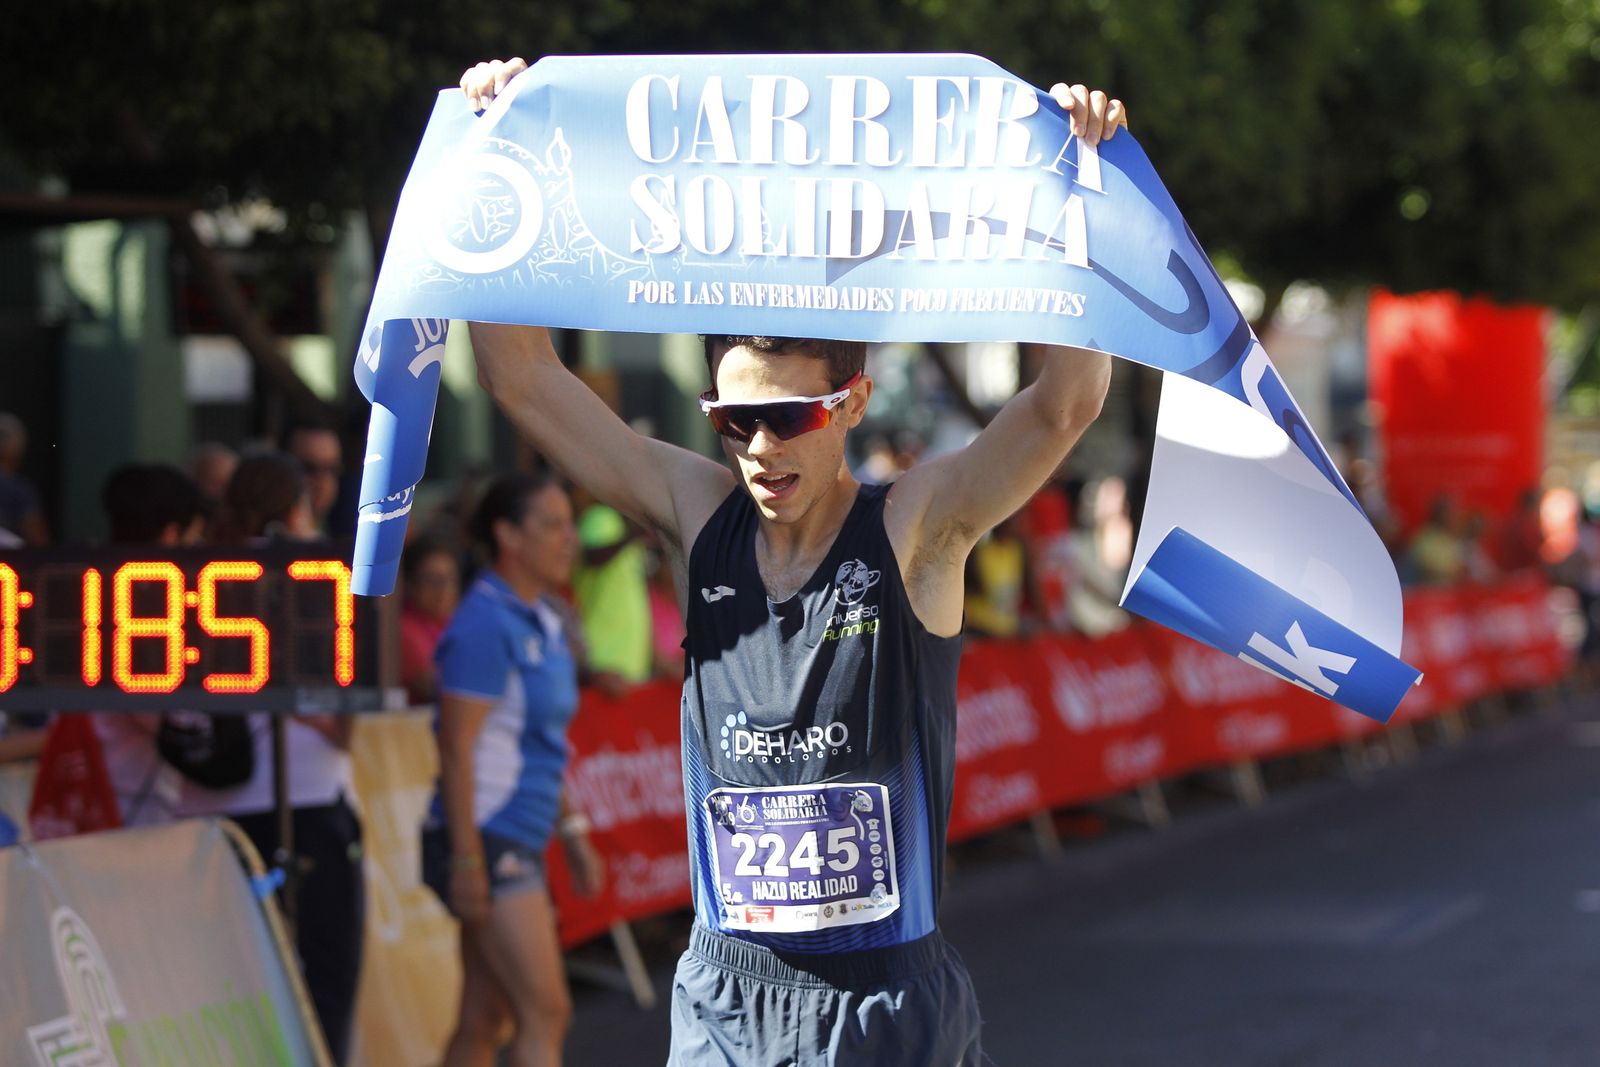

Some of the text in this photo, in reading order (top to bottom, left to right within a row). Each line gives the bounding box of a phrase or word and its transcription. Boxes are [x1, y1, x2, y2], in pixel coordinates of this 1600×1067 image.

[625, 74, 1108, 195] CARRERA
[629, 173, 1093, 269] SOLIDARIA
[628, 280, 1087, 318] POR LAS ENFERMEDADES POCO FRECUENTES
[0, 560, 354, 693] :18:57
[735, 721, 849, 757] DEHARO
[735, 745, 852, 764] PODOLOGOS
[761, 793, 827, 809] CARRERA
[762, 805, 828, 820] SOLIDARIA
[730, 827, 861, 877] 2245
[752, 875, 858, 901] HAZLO REALIDAD
